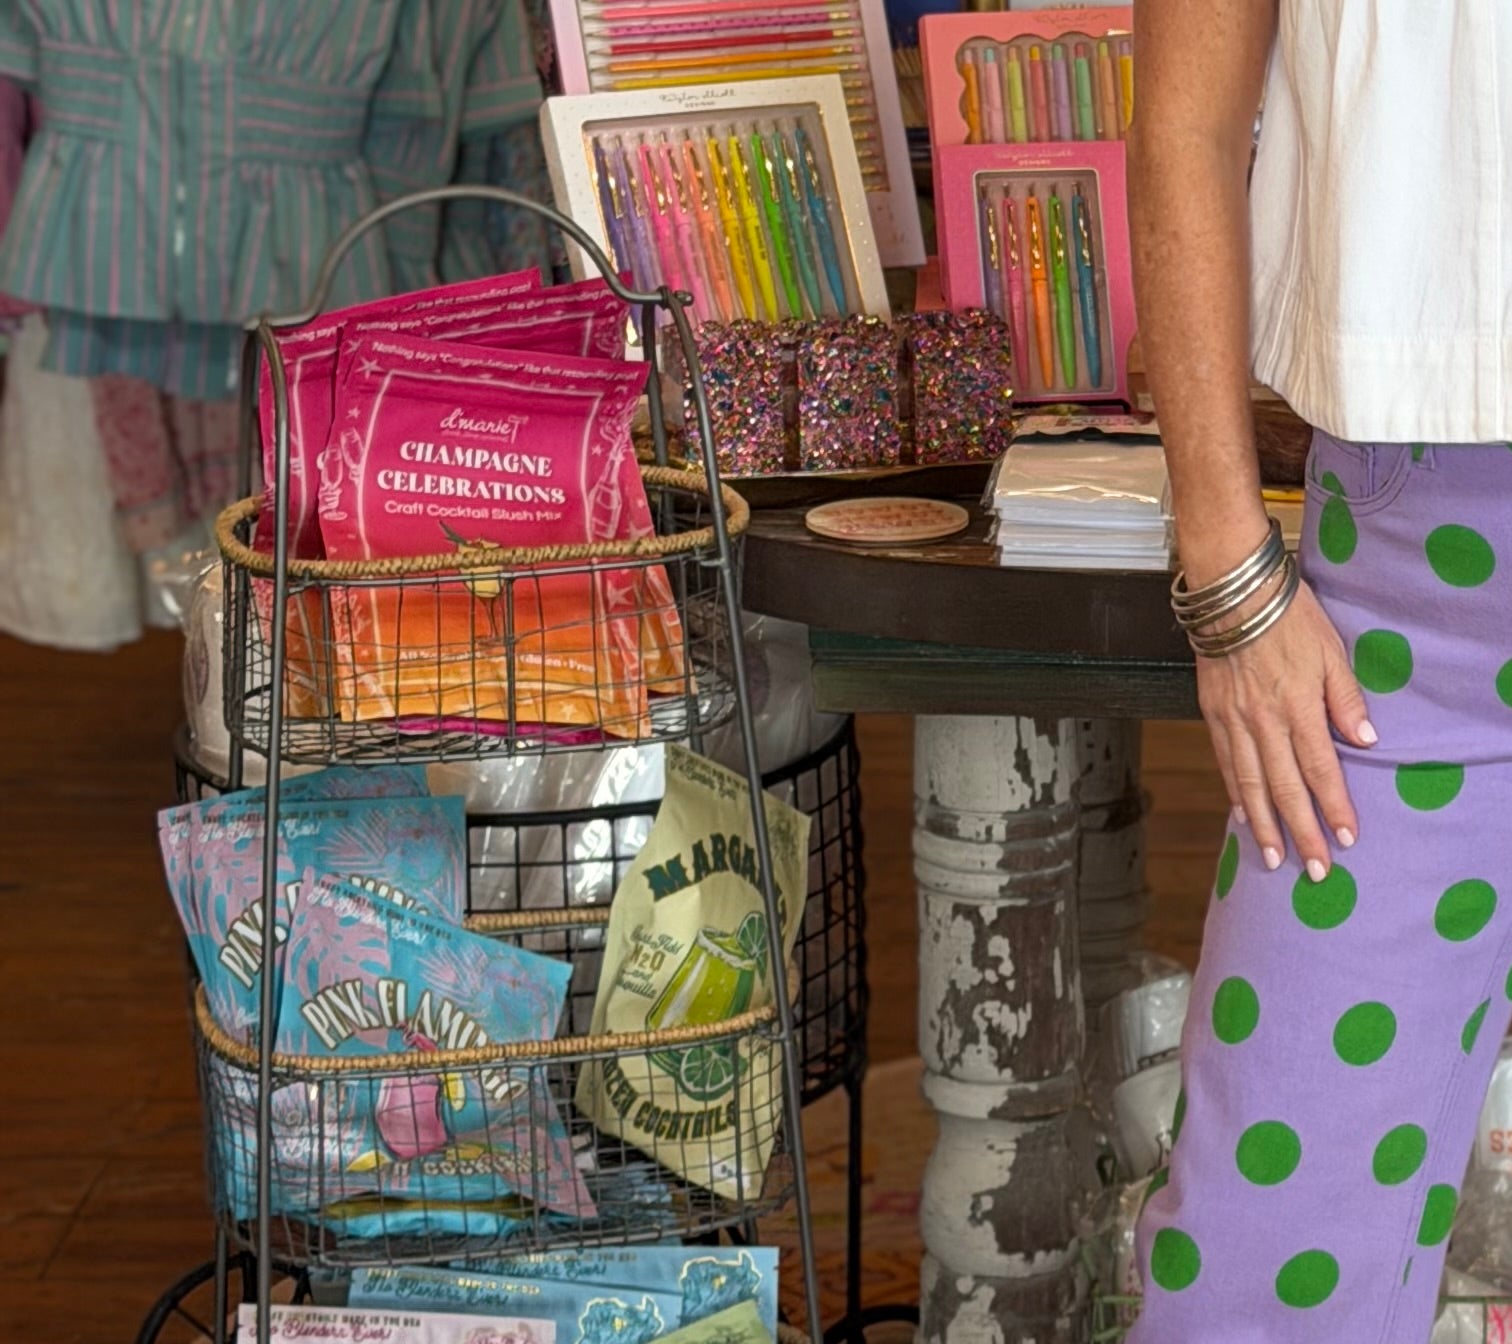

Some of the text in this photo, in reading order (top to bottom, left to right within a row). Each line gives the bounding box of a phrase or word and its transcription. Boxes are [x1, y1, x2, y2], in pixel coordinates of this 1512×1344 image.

[400, 441, 553, 477] CHAMPAGNE
[377, 469, 566, 505] CELEBRATIONS
[384, 500, 563, 523] Craft Cocktail Slush Mix
[299, 978, 381, 1051] PINK
